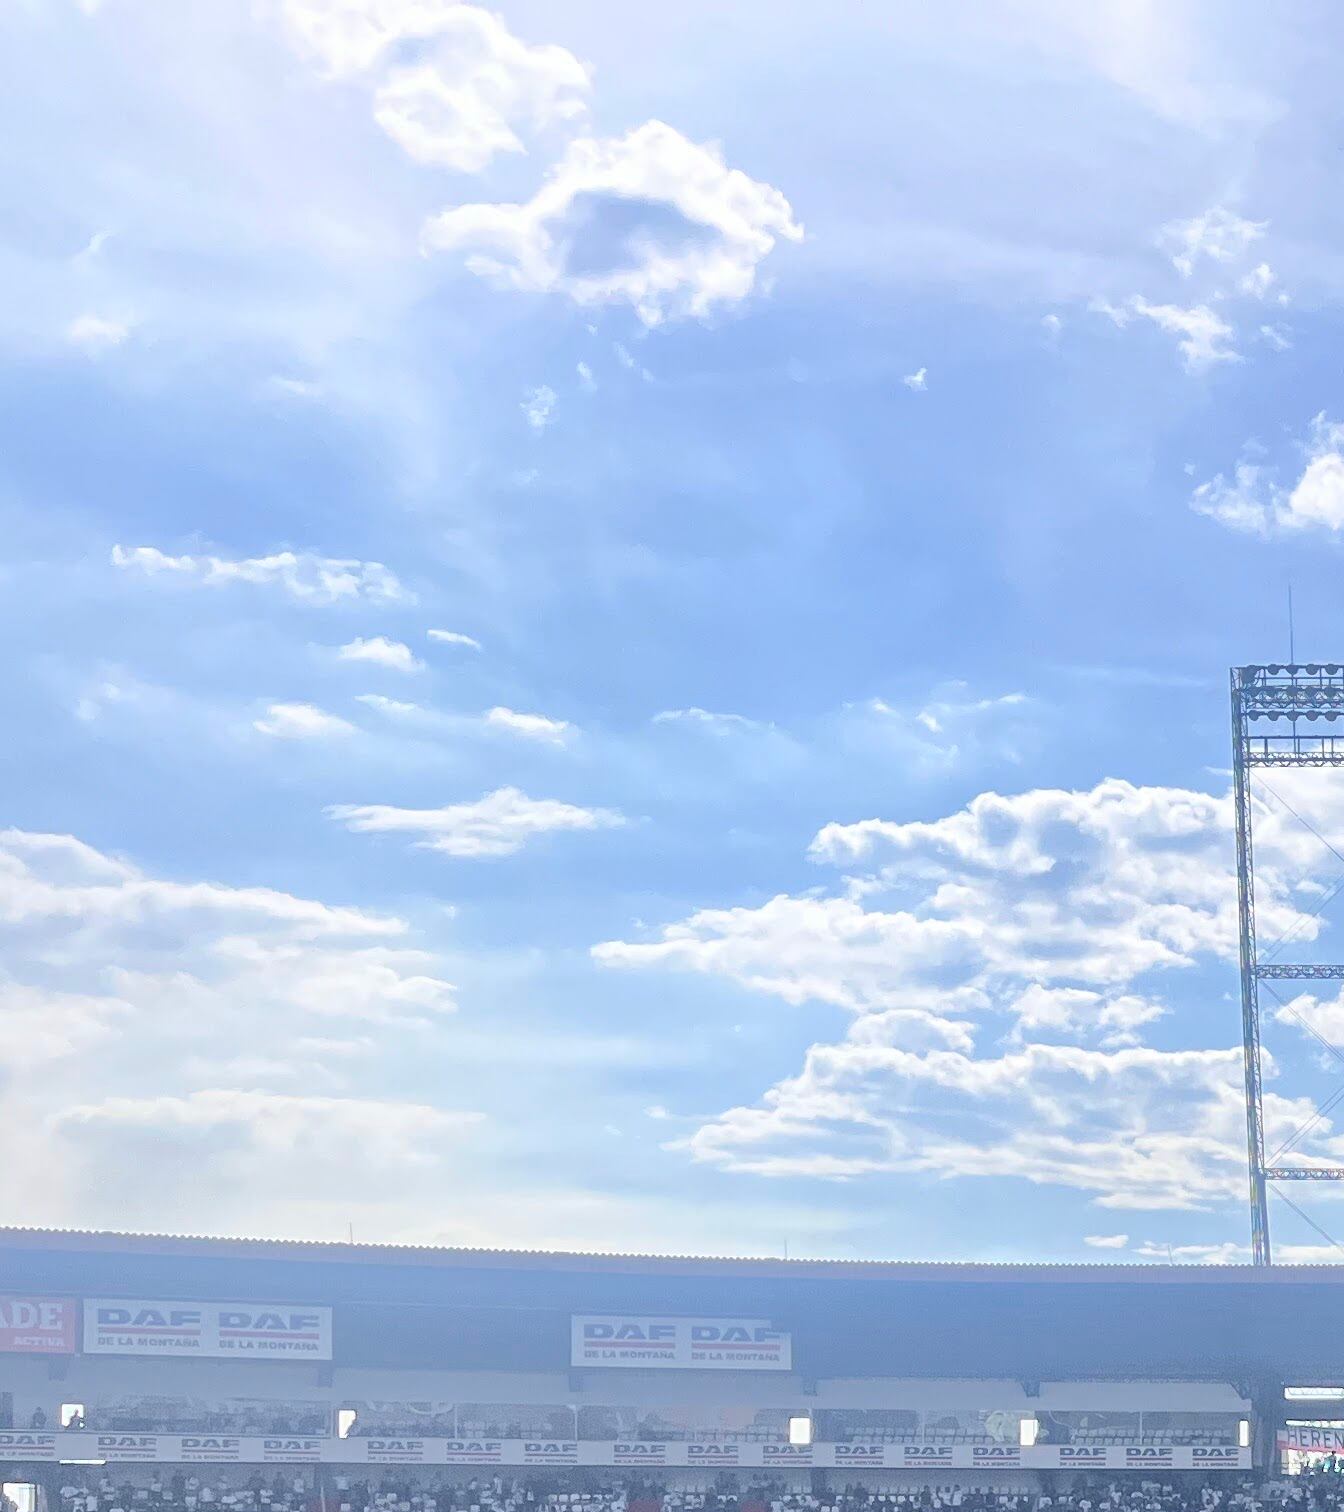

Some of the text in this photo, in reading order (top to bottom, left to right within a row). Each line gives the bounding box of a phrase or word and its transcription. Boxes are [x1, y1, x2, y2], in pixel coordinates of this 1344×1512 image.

[98, 1308, 320, 1330] DAF DAF
[584, 1324, 780, 1342] DAF DAF
[117, 1337, 134, 1347] LA
[238, 1340, 254, 1350] LA
[601, 1351, 616, 1359] LA
[0, 1435, 1239, 1457] DAF DAF DAF DAF DAF DAF DAF DAF DAF DAF DAF DAF DAF DAF DAF DAF
